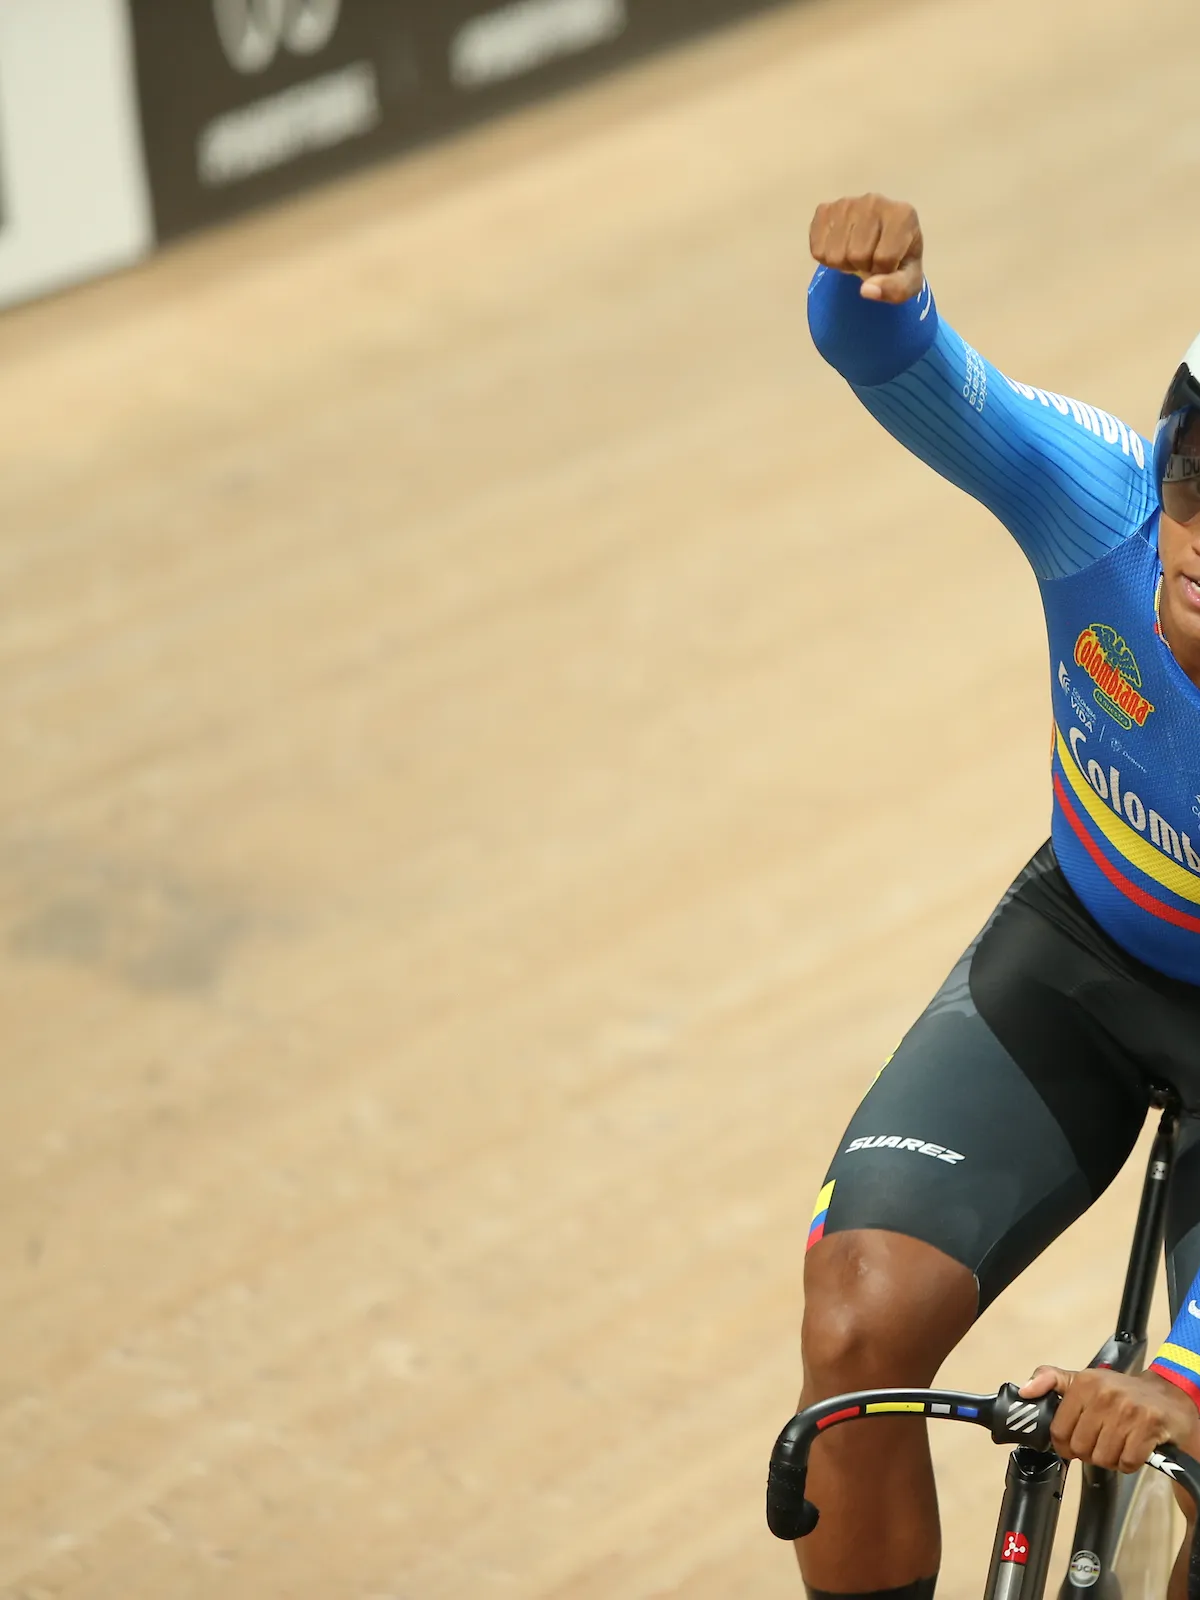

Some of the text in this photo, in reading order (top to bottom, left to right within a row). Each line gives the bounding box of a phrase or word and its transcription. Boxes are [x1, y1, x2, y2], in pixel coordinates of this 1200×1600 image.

[1074, 630, 1150, 726] Colombiana
[1071, 695, 1093, 733] VIDA
[844, 1135, 966, 1165] SUAREZ
[1077, 1564, 1094, 1573] UCI
